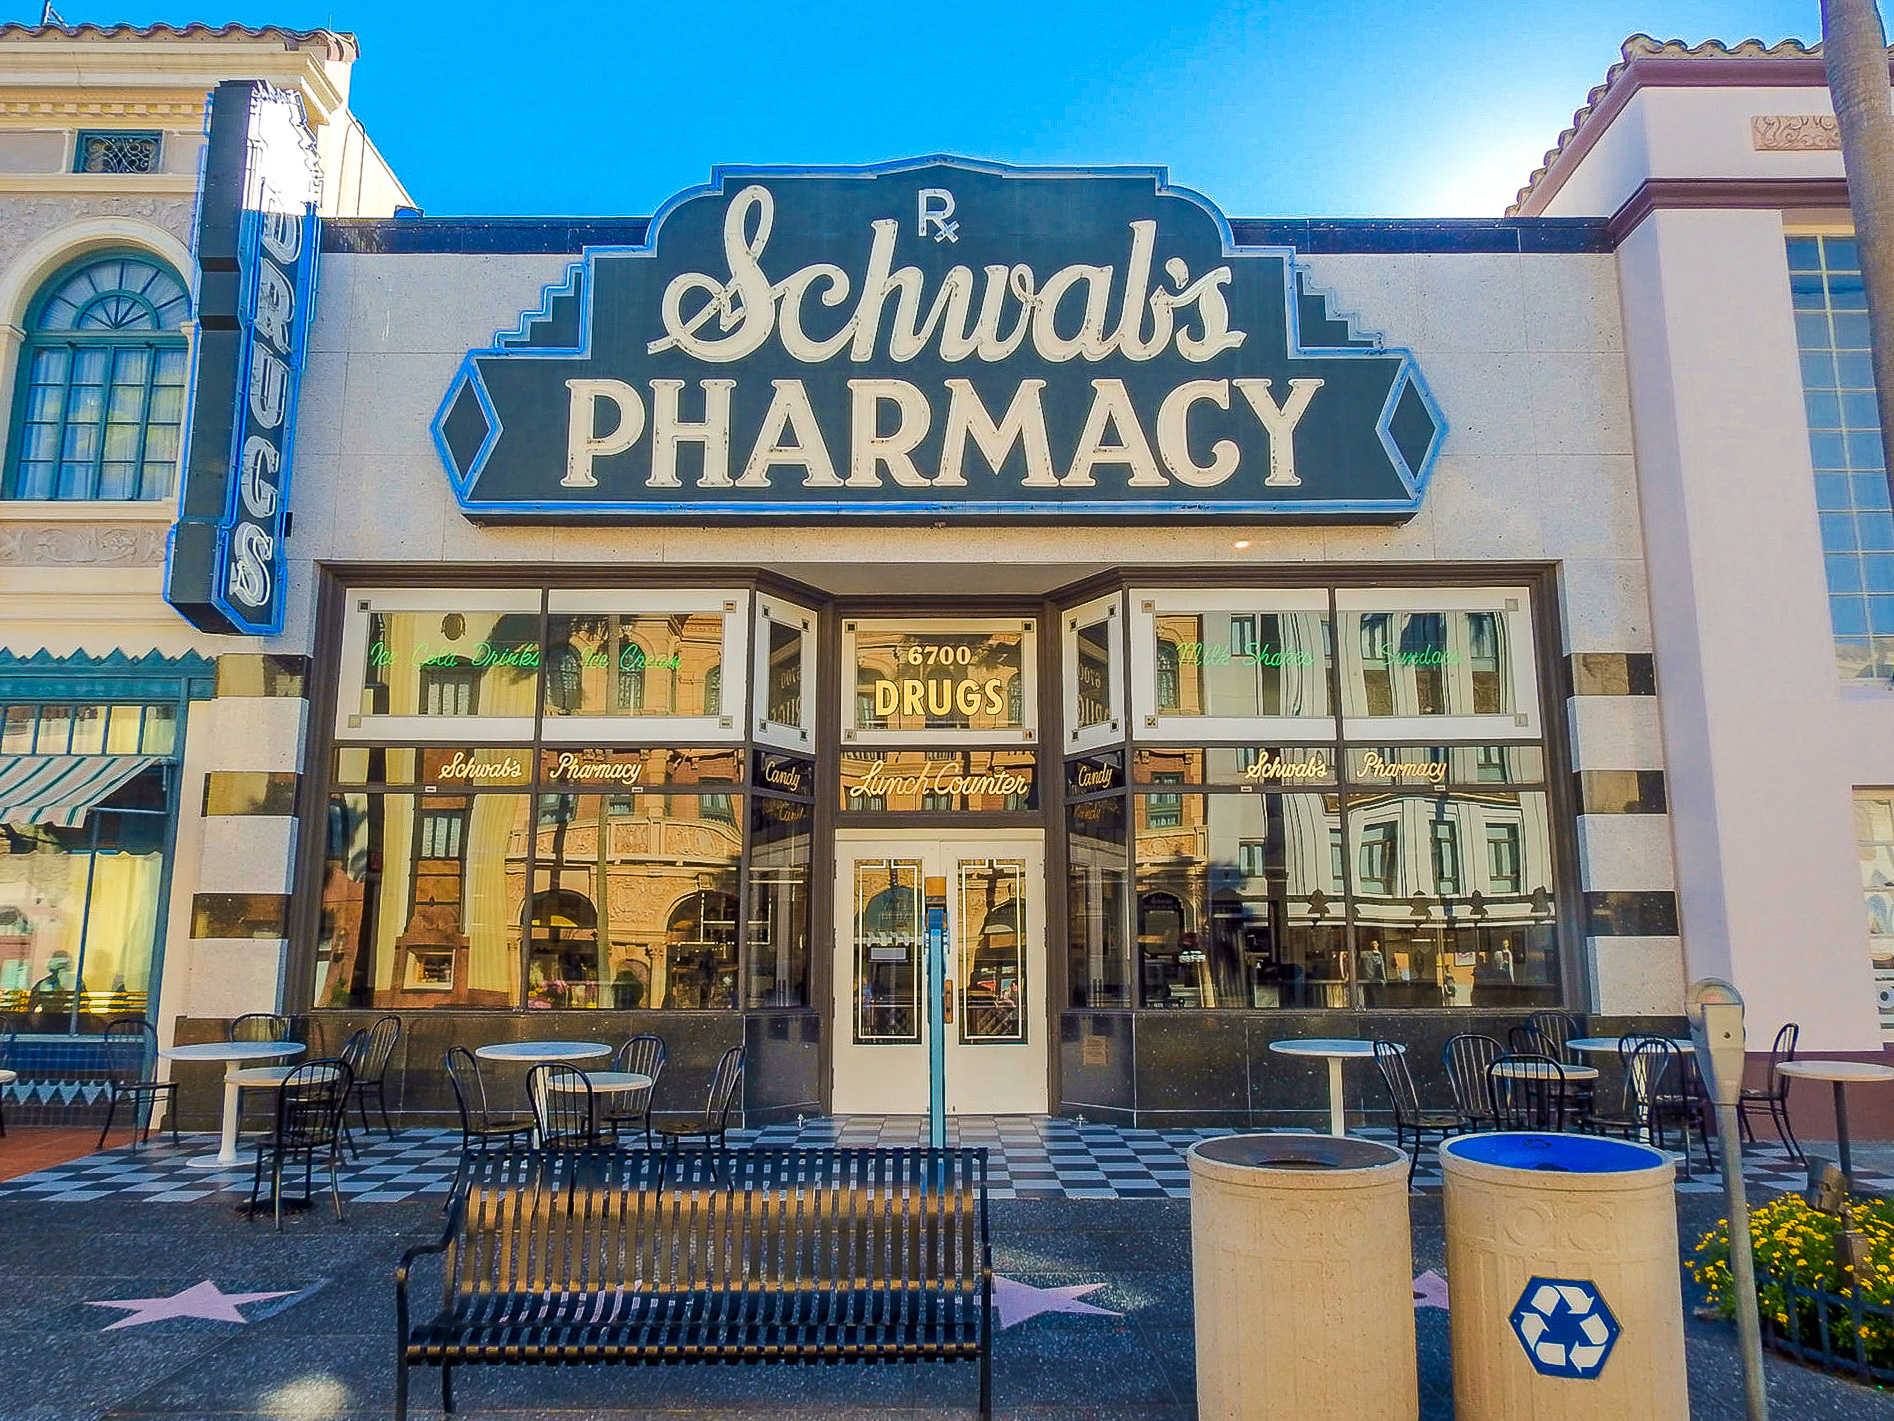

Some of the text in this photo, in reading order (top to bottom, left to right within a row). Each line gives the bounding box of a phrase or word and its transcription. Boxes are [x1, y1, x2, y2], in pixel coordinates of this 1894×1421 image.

[647, 184, 1247, 363] Schwab's
[559, 377, 1326, 489] PHARMACY
[370, 641, 540, 668] Ice Cold Drinks
[580, 643, 682, 670] Ice Cream
[907, 645, 972, 666] 6700
[1175, 641, 1316, 668] Milk Shakes
[874, 678, 1005, 717] DRUGS
[438, 751, 643, 785] Schwab's Pharmacy
[765, 760, 801, 792] Candy
[850, 760, 1029, 798] Lunch Counter
[1078, 762, 1113, 789] Candy
[1244, 751, 1448, 784] Schwab's Pharmacy
